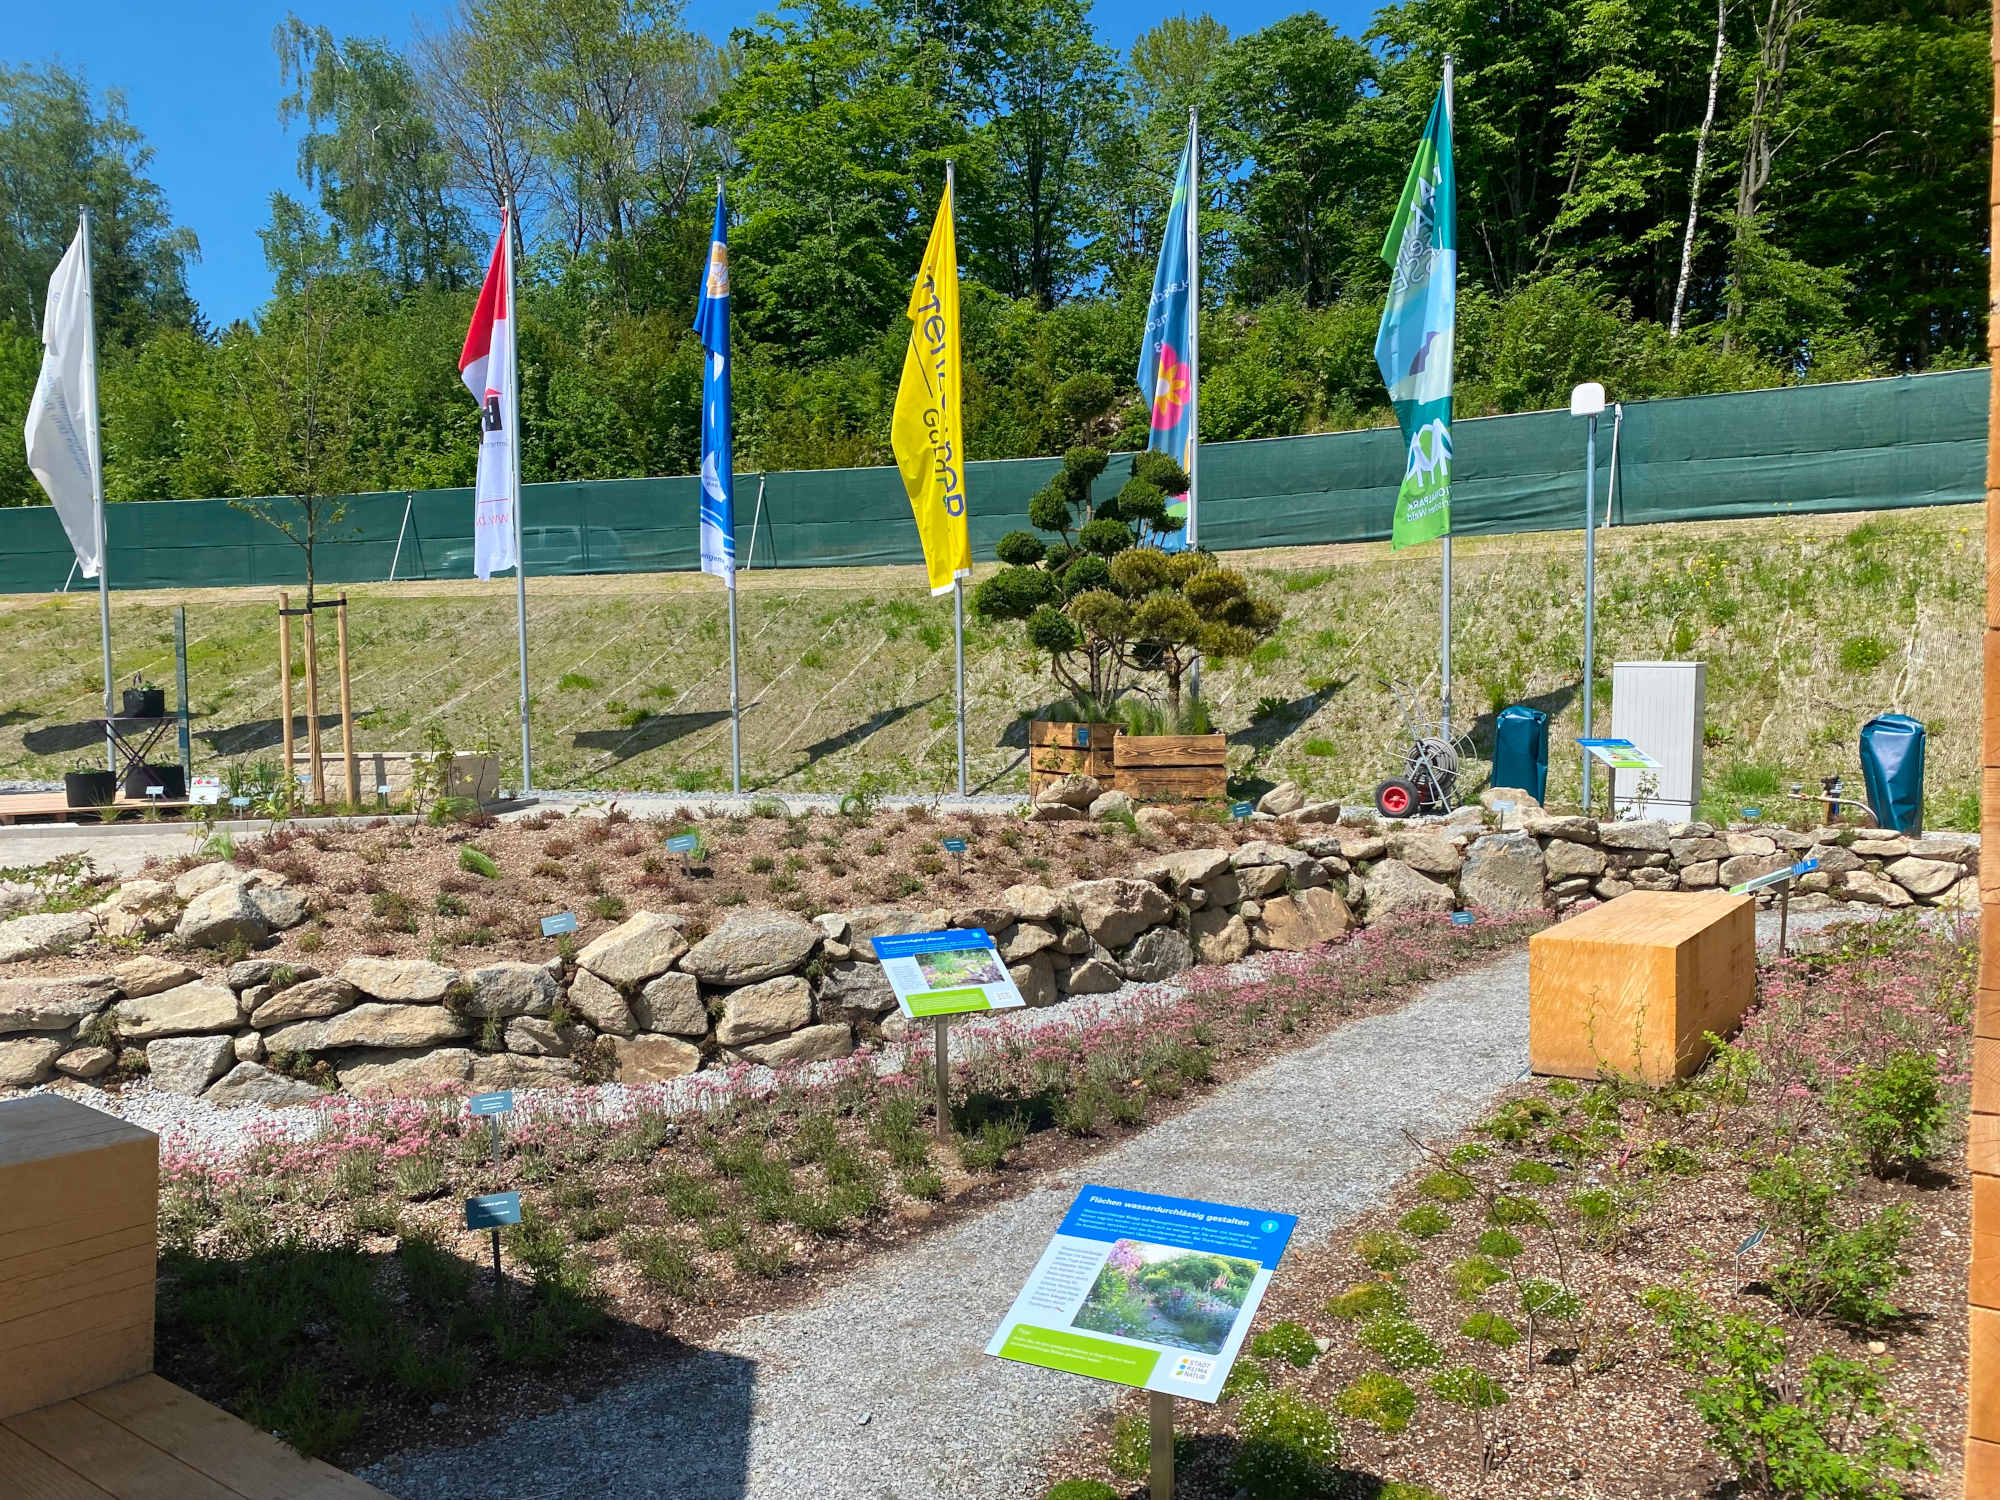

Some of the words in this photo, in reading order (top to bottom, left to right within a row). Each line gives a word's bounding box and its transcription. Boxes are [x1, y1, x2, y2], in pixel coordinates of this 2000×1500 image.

[1089, 1195, 1123, 1207] Flächen
[1123, 1201, 1206, 1220] wasserdurchlässig
[1206, 1214, 1250, 1227] gestalten
